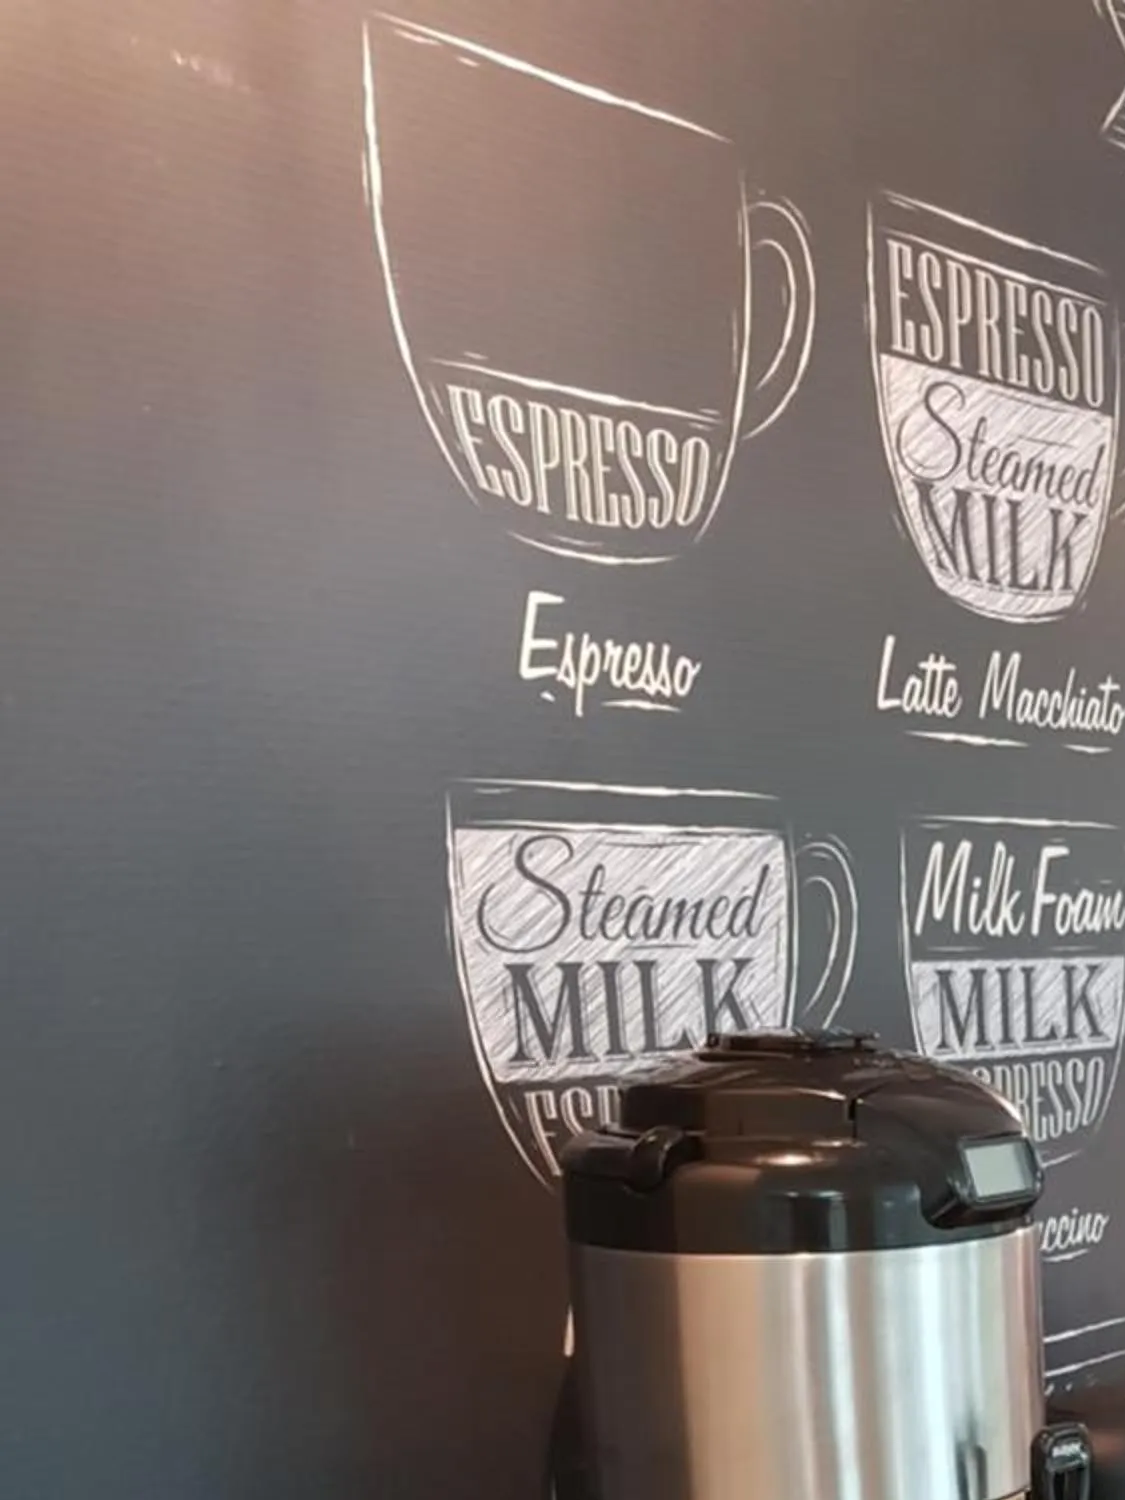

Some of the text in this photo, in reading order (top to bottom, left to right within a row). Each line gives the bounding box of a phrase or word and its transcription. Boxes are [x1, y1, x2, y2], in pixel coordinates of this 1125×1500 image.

[886, 238, 1104, 409] ESPRESSO
[445, 384, 711, 529] ESPRESSO
[896, 380, 1106, 508] Steamed
[911, 478, 1088, 592] MILK
[517, 591, 702, 716] Espresso
[876, 635, 962, 719] Latte
[478, 834, 767, 952] Steamed
[915, 841, 1024, 936] Milk
[503, 958, 760, 1063] MILK
[936, 965, 1105, 1050] MILK
